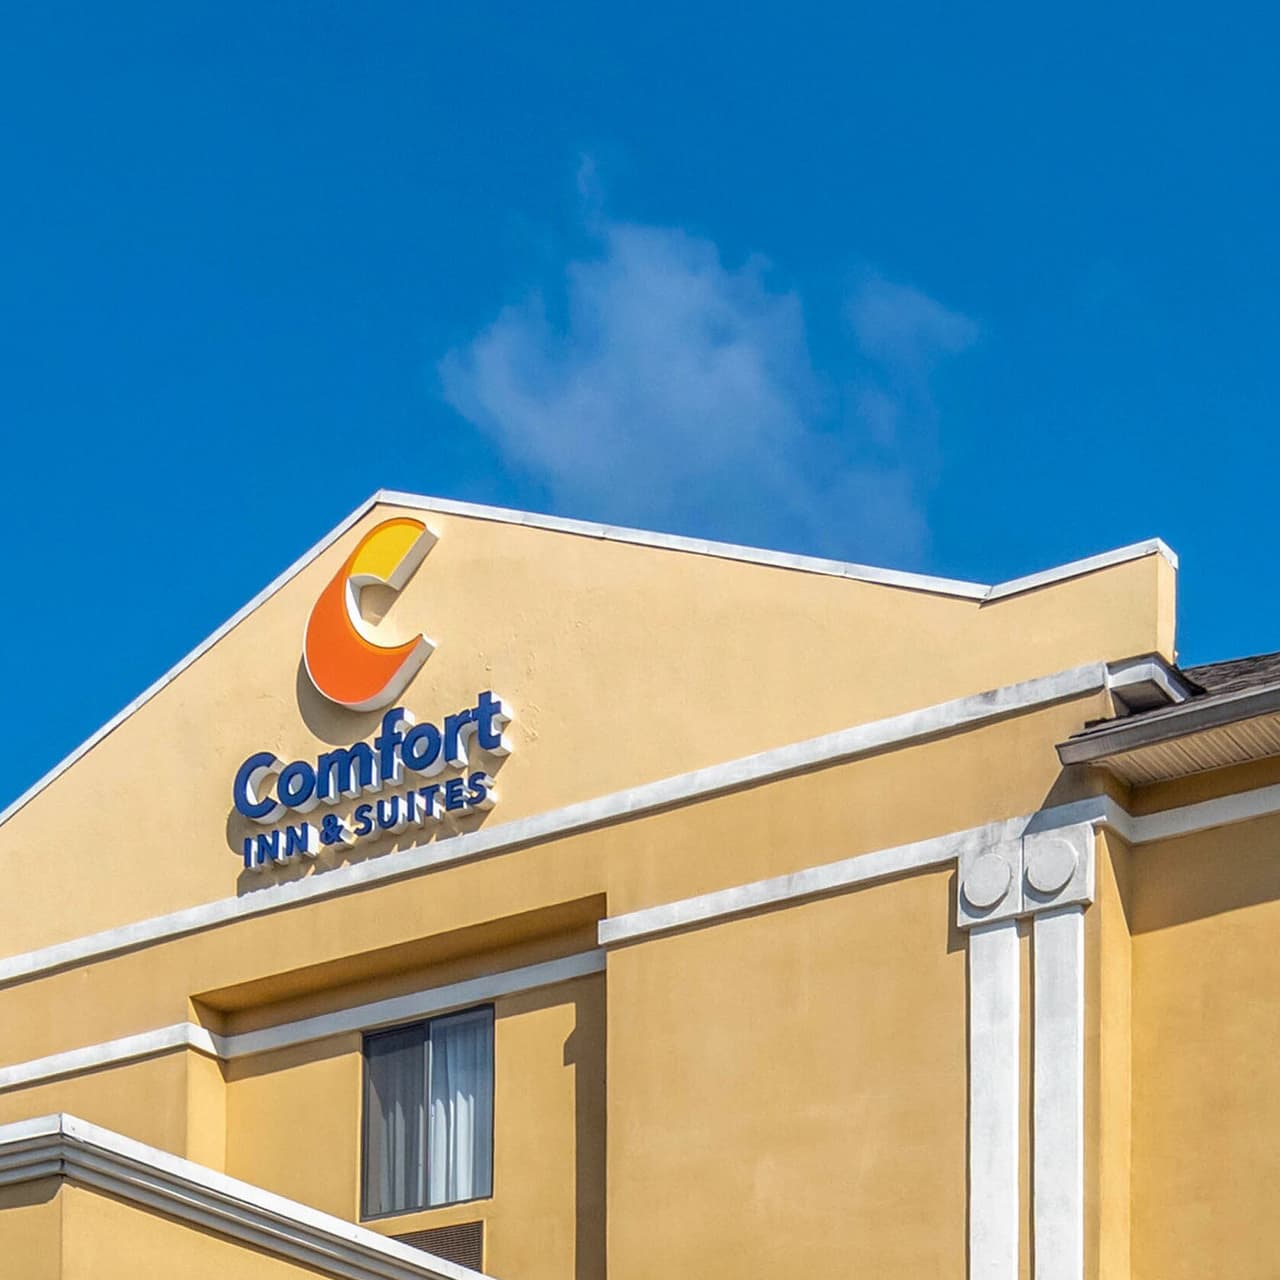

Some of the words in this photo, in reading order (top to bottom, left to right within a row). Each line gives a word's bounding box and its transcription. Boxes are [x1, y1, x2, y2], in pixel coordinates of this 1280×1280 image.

[233, 690, 507, 819] Comfort
[243, 821, 312, 869] INN
[320, 813, 345, 846] &
[353, 771, 489, 836] SUITES
